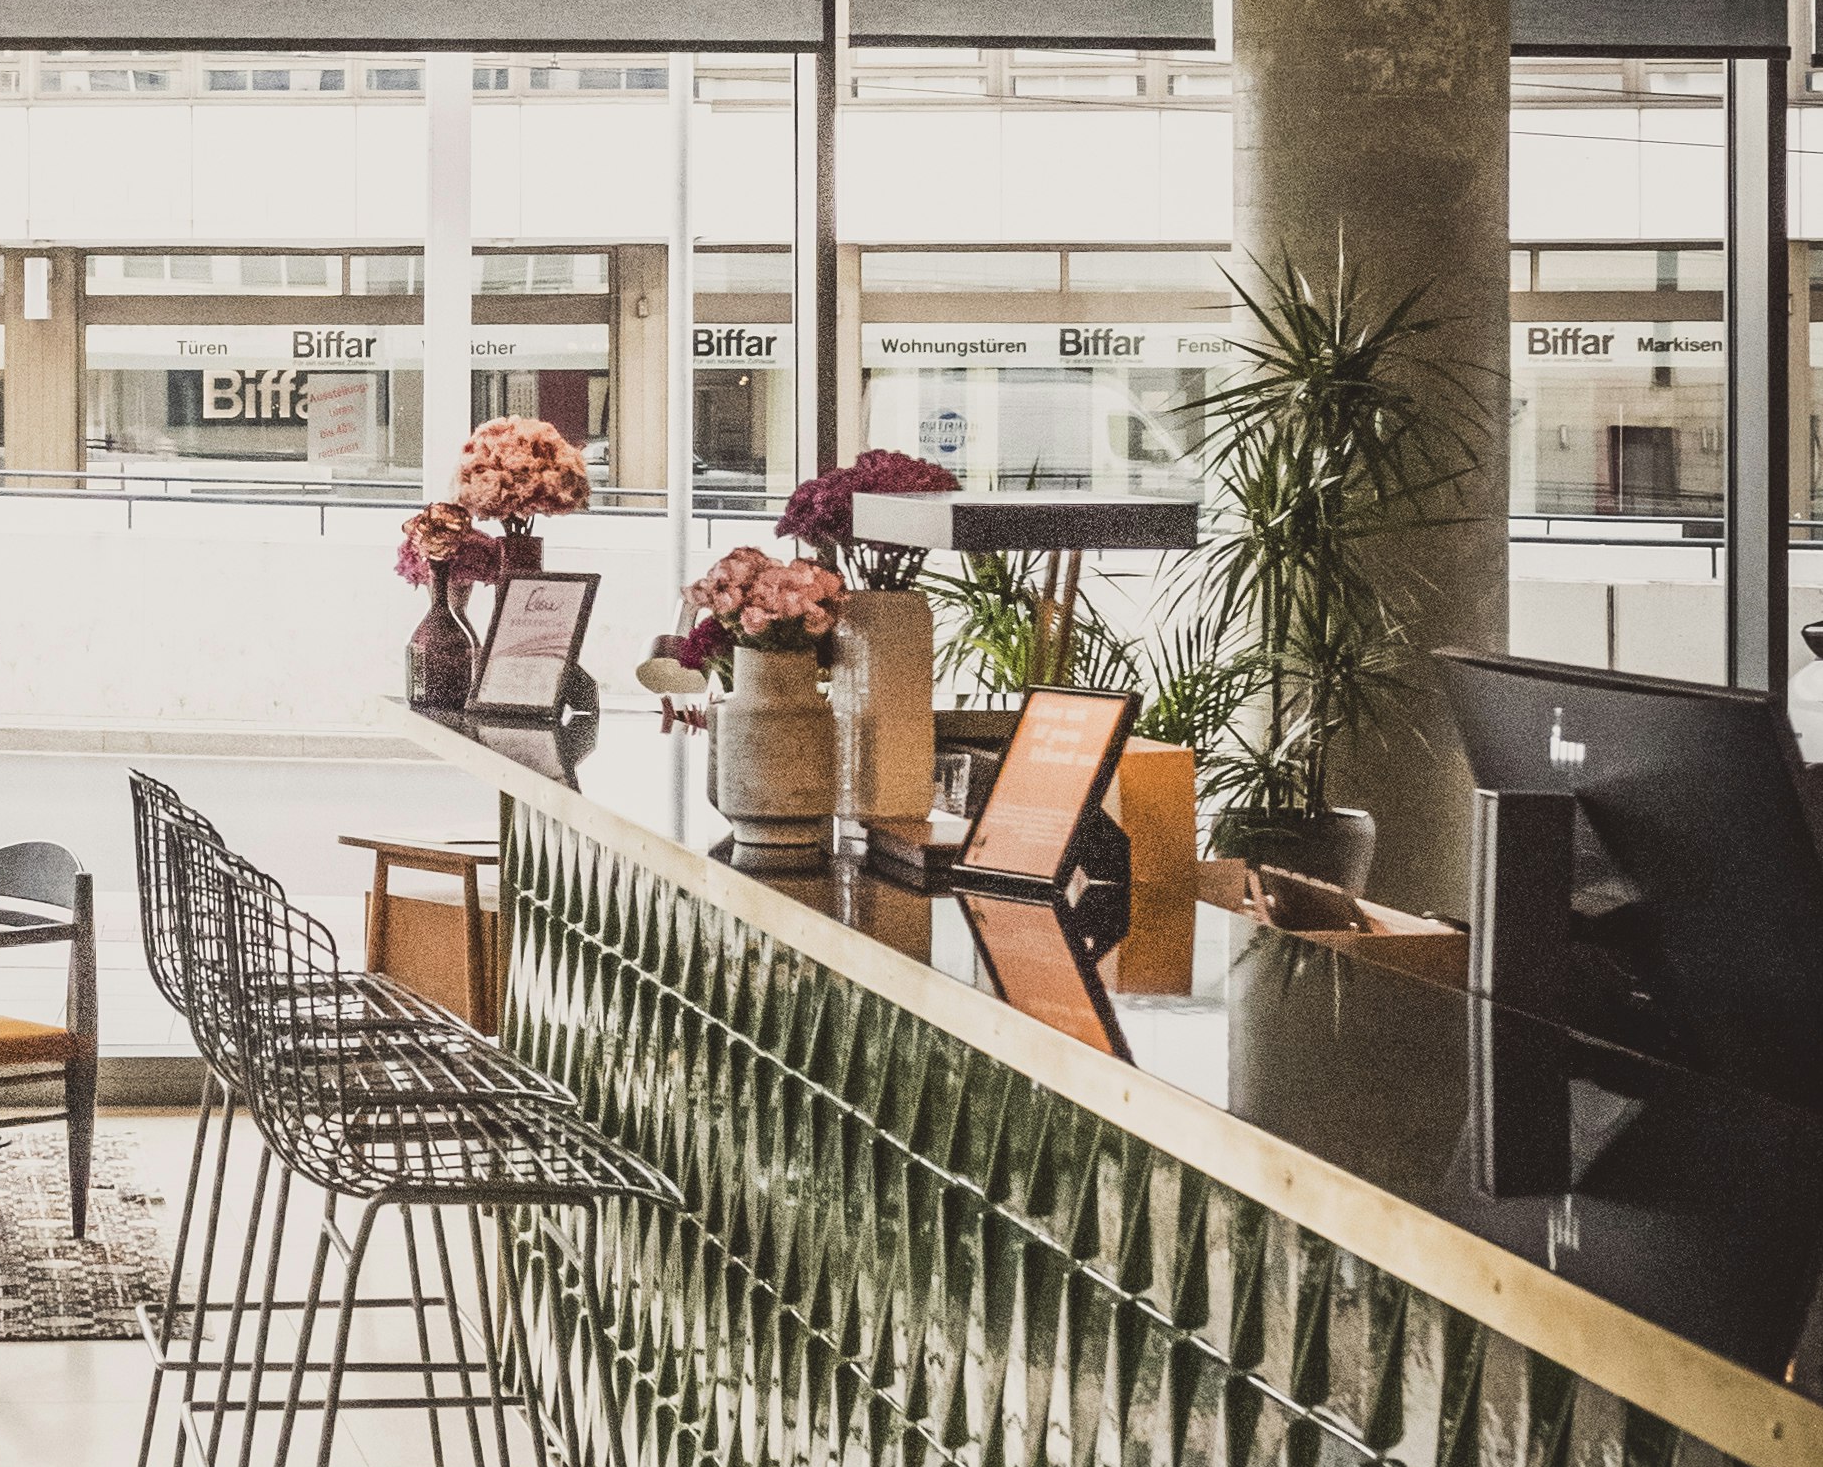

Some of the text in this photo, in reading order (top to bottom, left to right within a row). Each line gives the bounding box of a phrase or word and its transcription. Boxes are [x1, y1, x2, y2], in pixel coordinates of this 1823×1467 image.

[177, 340, 228, 356] Türen
[293, 330, 377, 359] Biffar
[692, 328, 778, 357] Biffar
[881, 338, 1027, 355] Wohnungstüren
[1059, 328, 1145, 356] Biffar
[1177, 338, 1232, 354] Fenst
[1527, 327, 1615, 356] Biffar
[1637, 336, 1723, 353] Markisen
[203, 369, 308, 419] Biff
